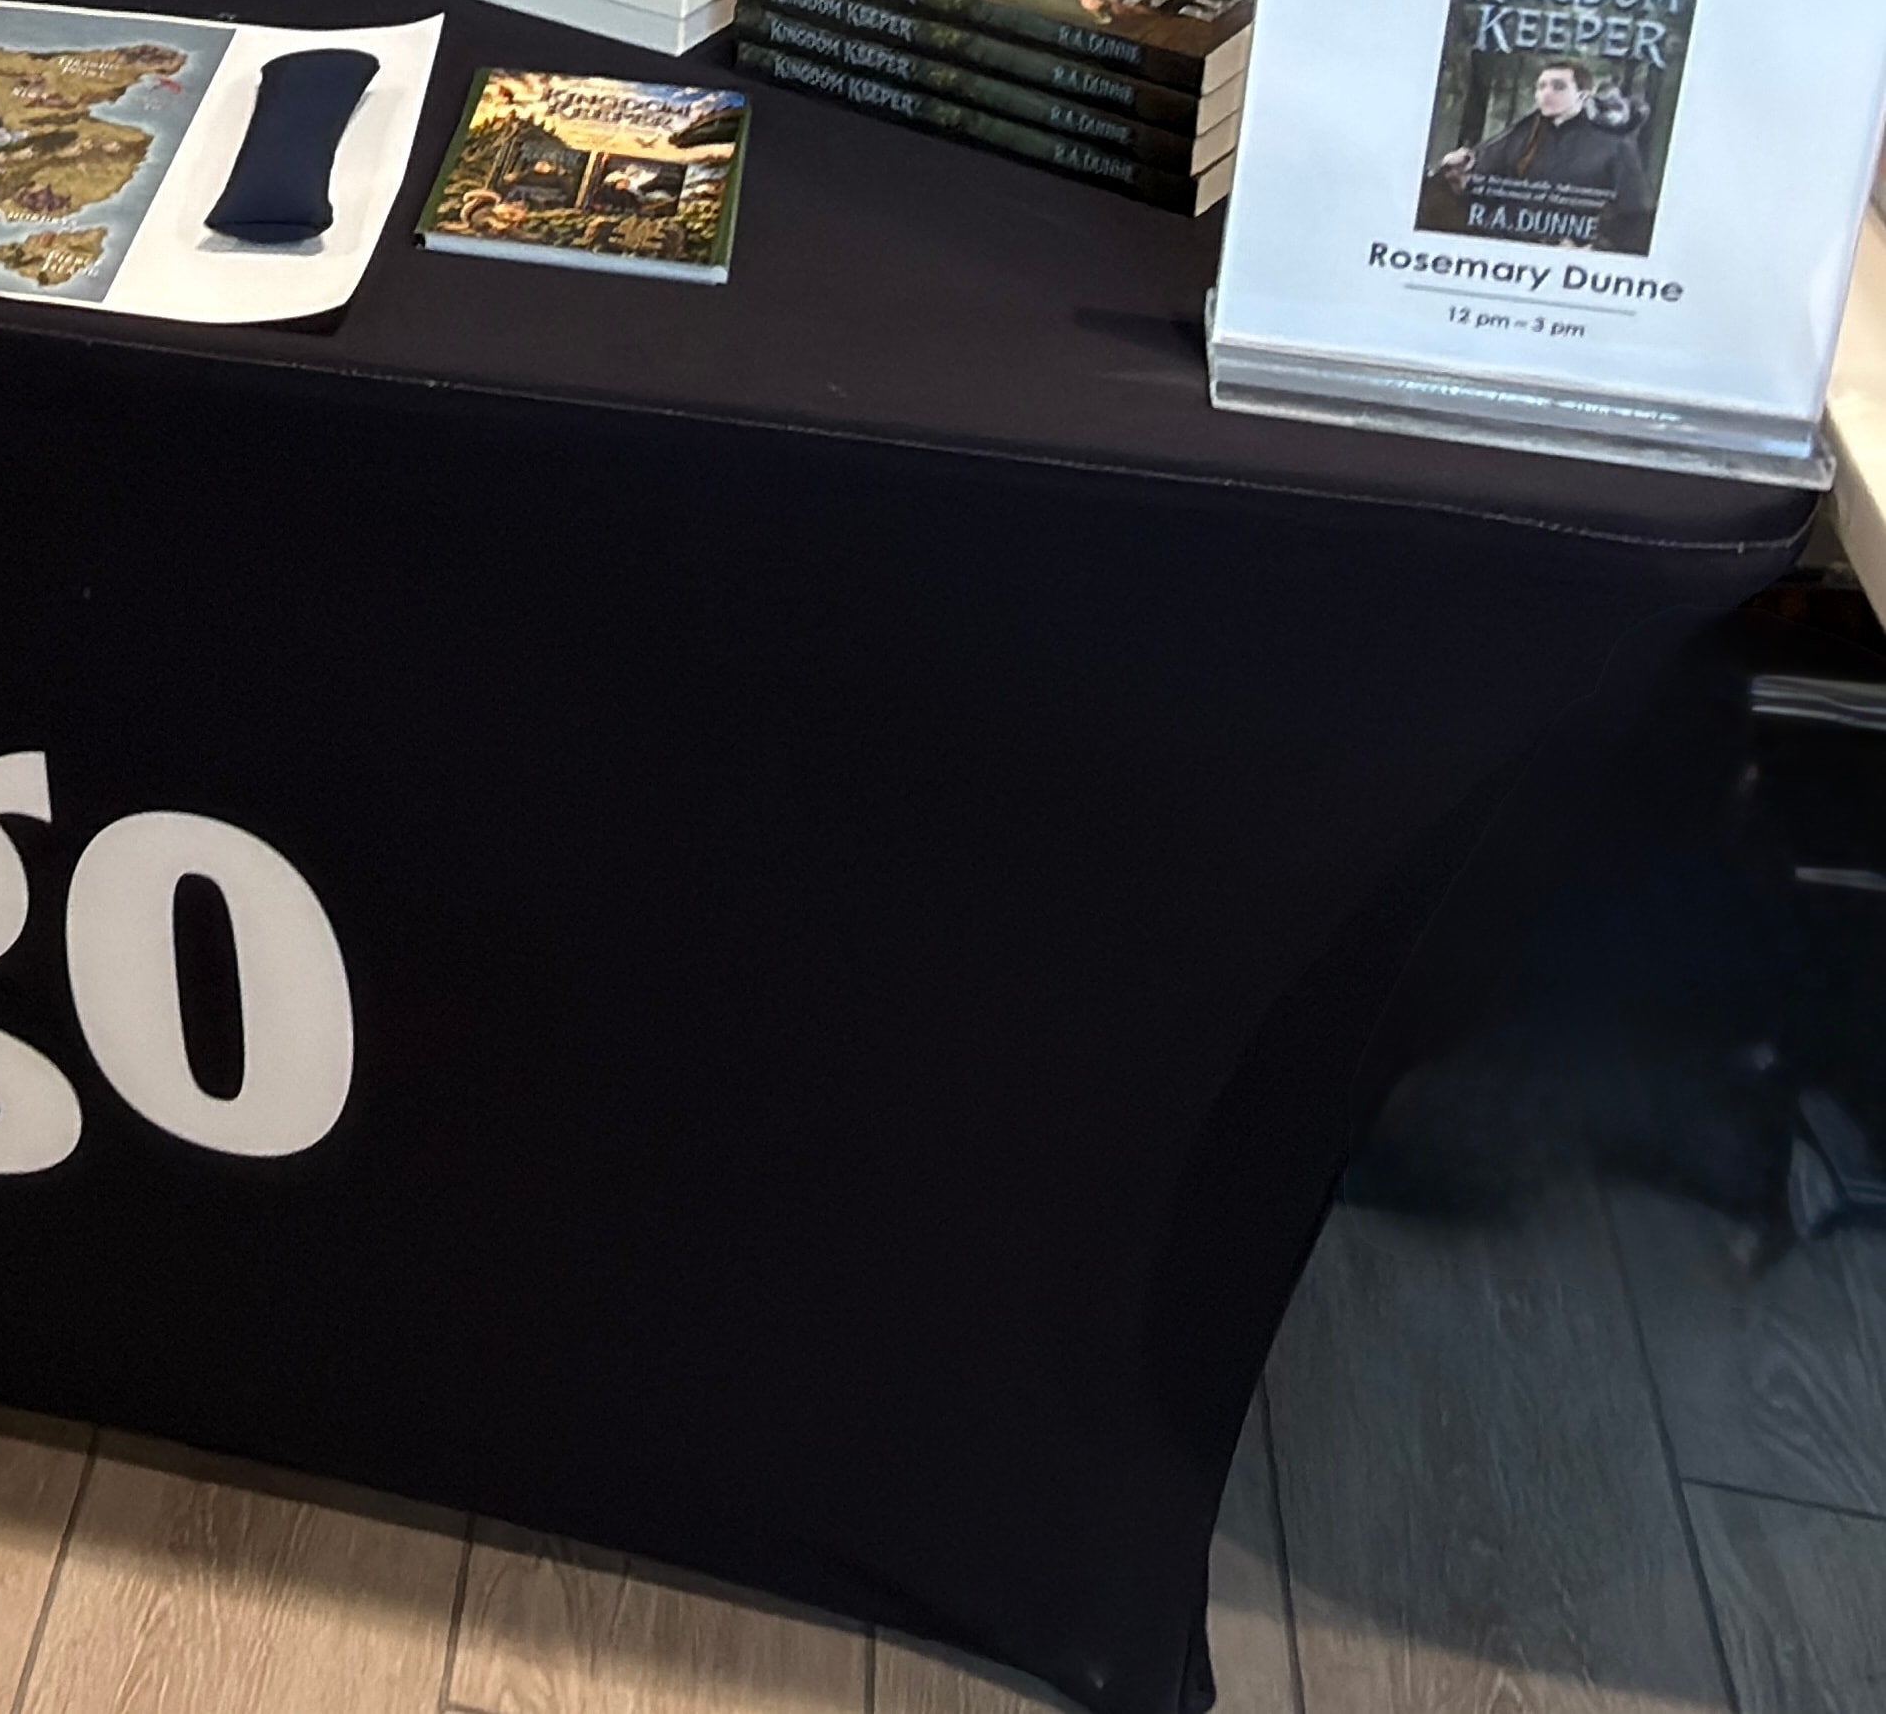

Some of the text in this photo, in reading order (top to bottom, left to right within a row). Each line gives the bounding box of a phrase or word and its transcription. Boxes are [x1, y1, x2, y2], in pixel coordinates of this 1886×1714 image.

[770, 17, 841, 57] KINGDOM
[844, 41, 910, 79] KEEPER
[846, 1, 913, 42] KEEPER
[1474, 4, 1667, 70] KEEPER
[774, 55, 845, 94] KINGDOM
[848, 77, 914, 117] KEEPER
[1515, 208, 1600, 240] DUNNE
[1368, 242, 1684, 302] Rosemary Dunne
[1448, 305, 1470, 325] 12
[1475, 312, 1510, 331] pm
[1530, 316, 1545, 333] 3
[1550, 319, 1585, 338] pm
